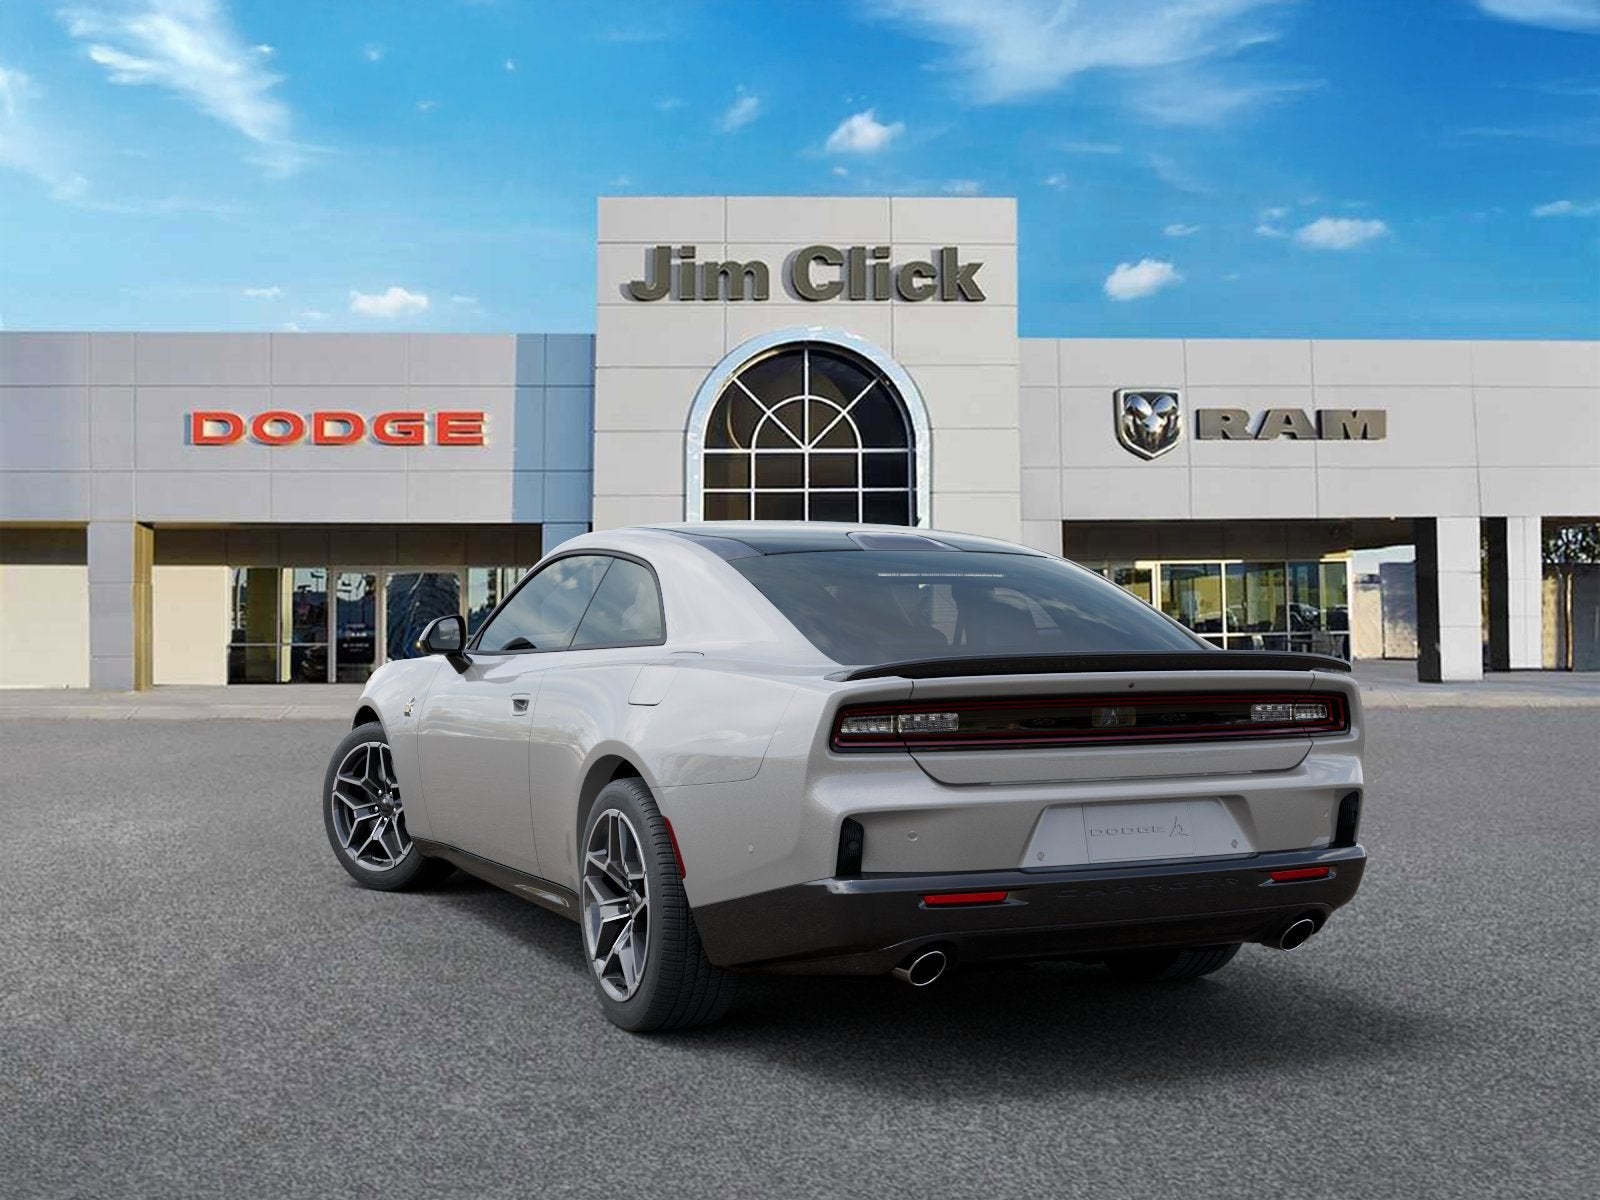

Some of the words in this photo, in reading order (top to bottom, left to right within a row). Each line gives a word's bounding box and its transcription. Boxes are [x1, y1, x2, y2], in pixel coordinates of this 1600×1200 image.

[629, 245, 770, 300] Jim
[790, 245, 986, 301] Click
[190, 411, 485, 446] DODGE
[1195, 408, 1387, 440] RAM
[1089, 825, 1167, 837] DODGE
